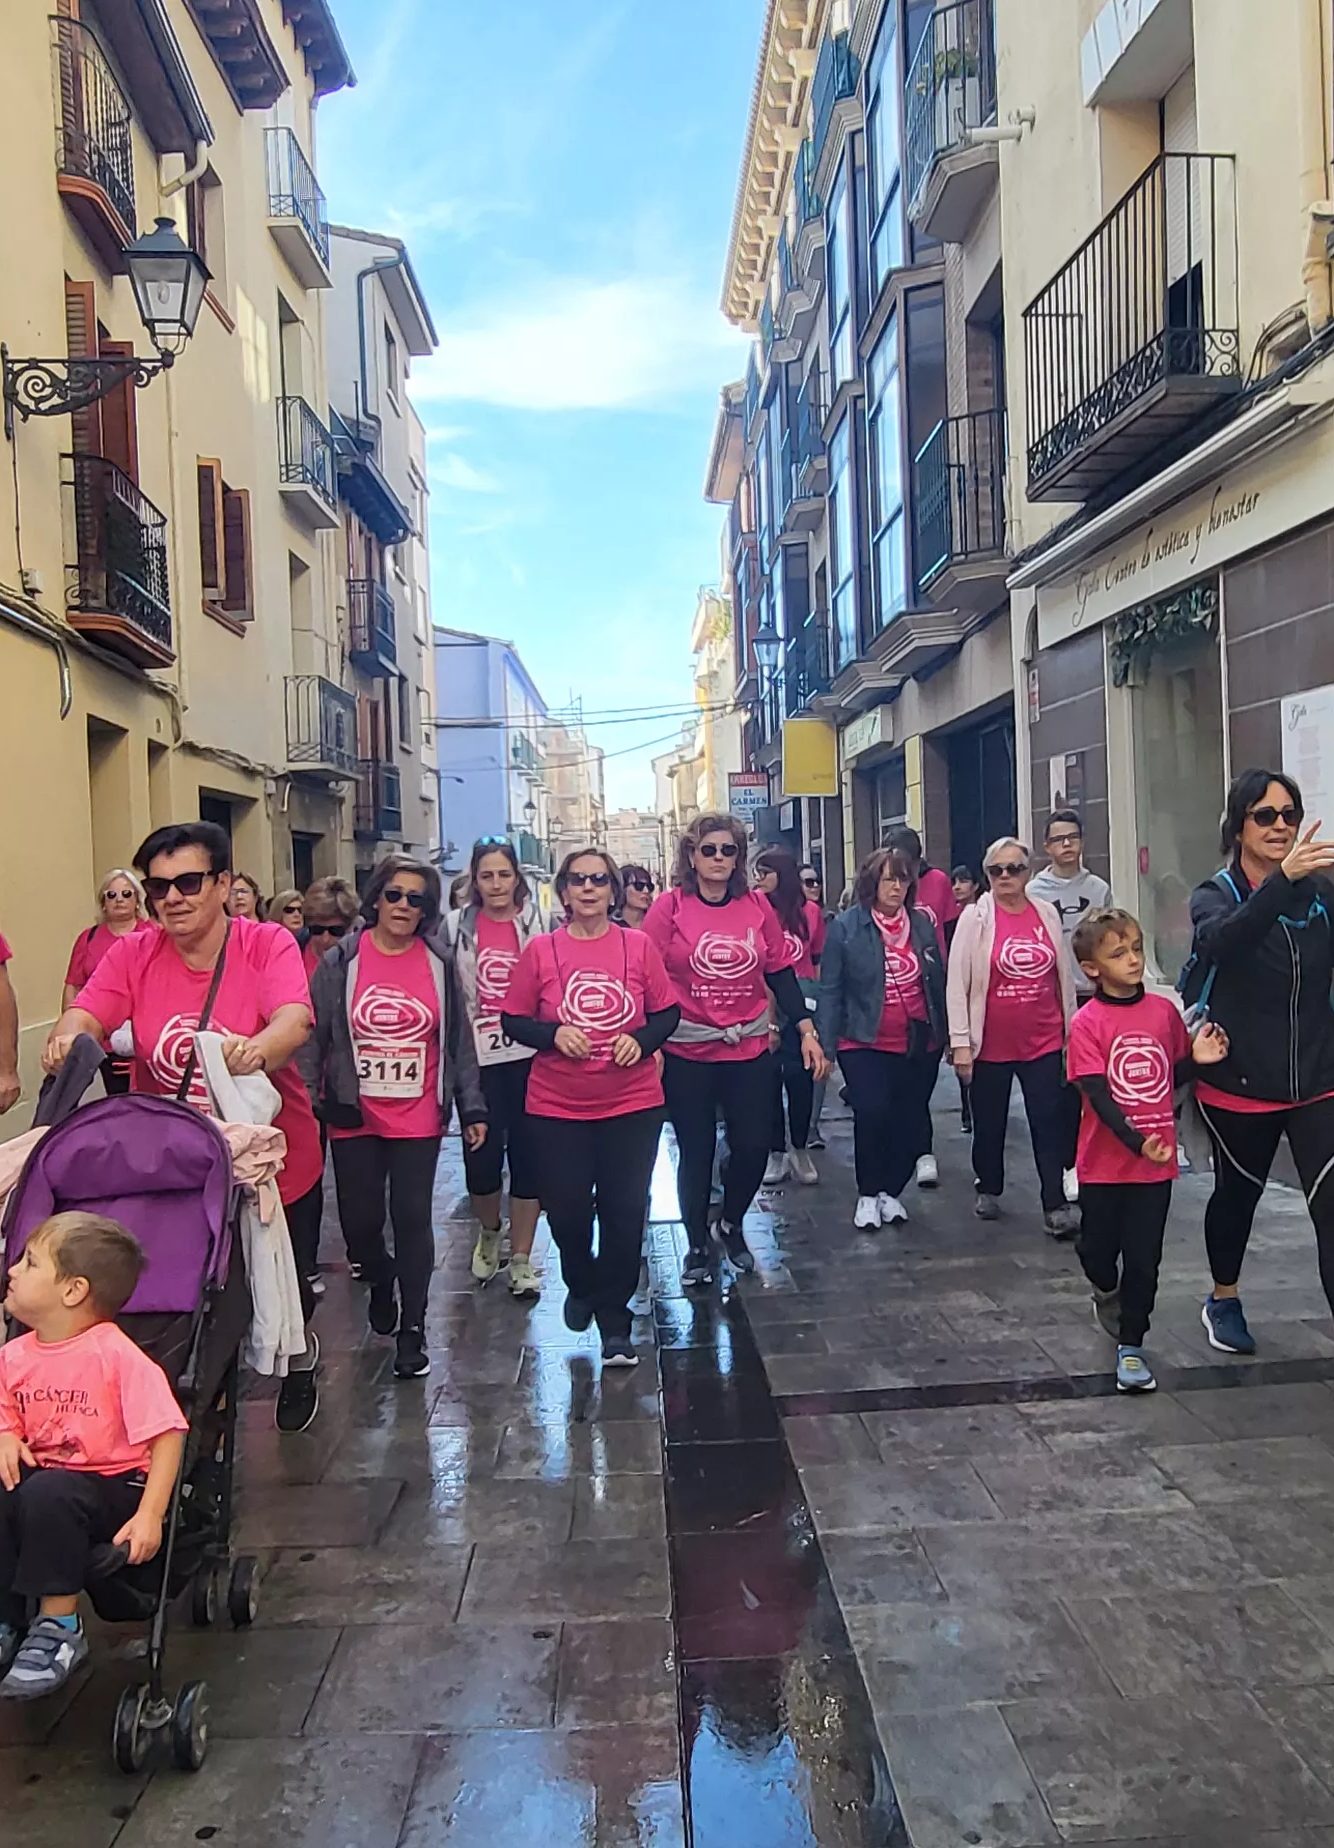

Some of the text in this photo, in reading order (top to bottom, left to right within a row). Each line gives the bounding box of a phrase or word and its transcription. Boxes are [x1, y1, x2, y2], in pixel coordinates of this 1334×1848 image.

[1104, 556, 1136, 592] Centro
[1141, 527, 1154, 570] de
[1190, 521, 1203, 565] y
[1208, 485, 1261, 537] bienestar
[744, 788, 755, 796] EL
[731, 797, 767, 806] CARMEN
[358, 1059, 418, 1081] 3114
